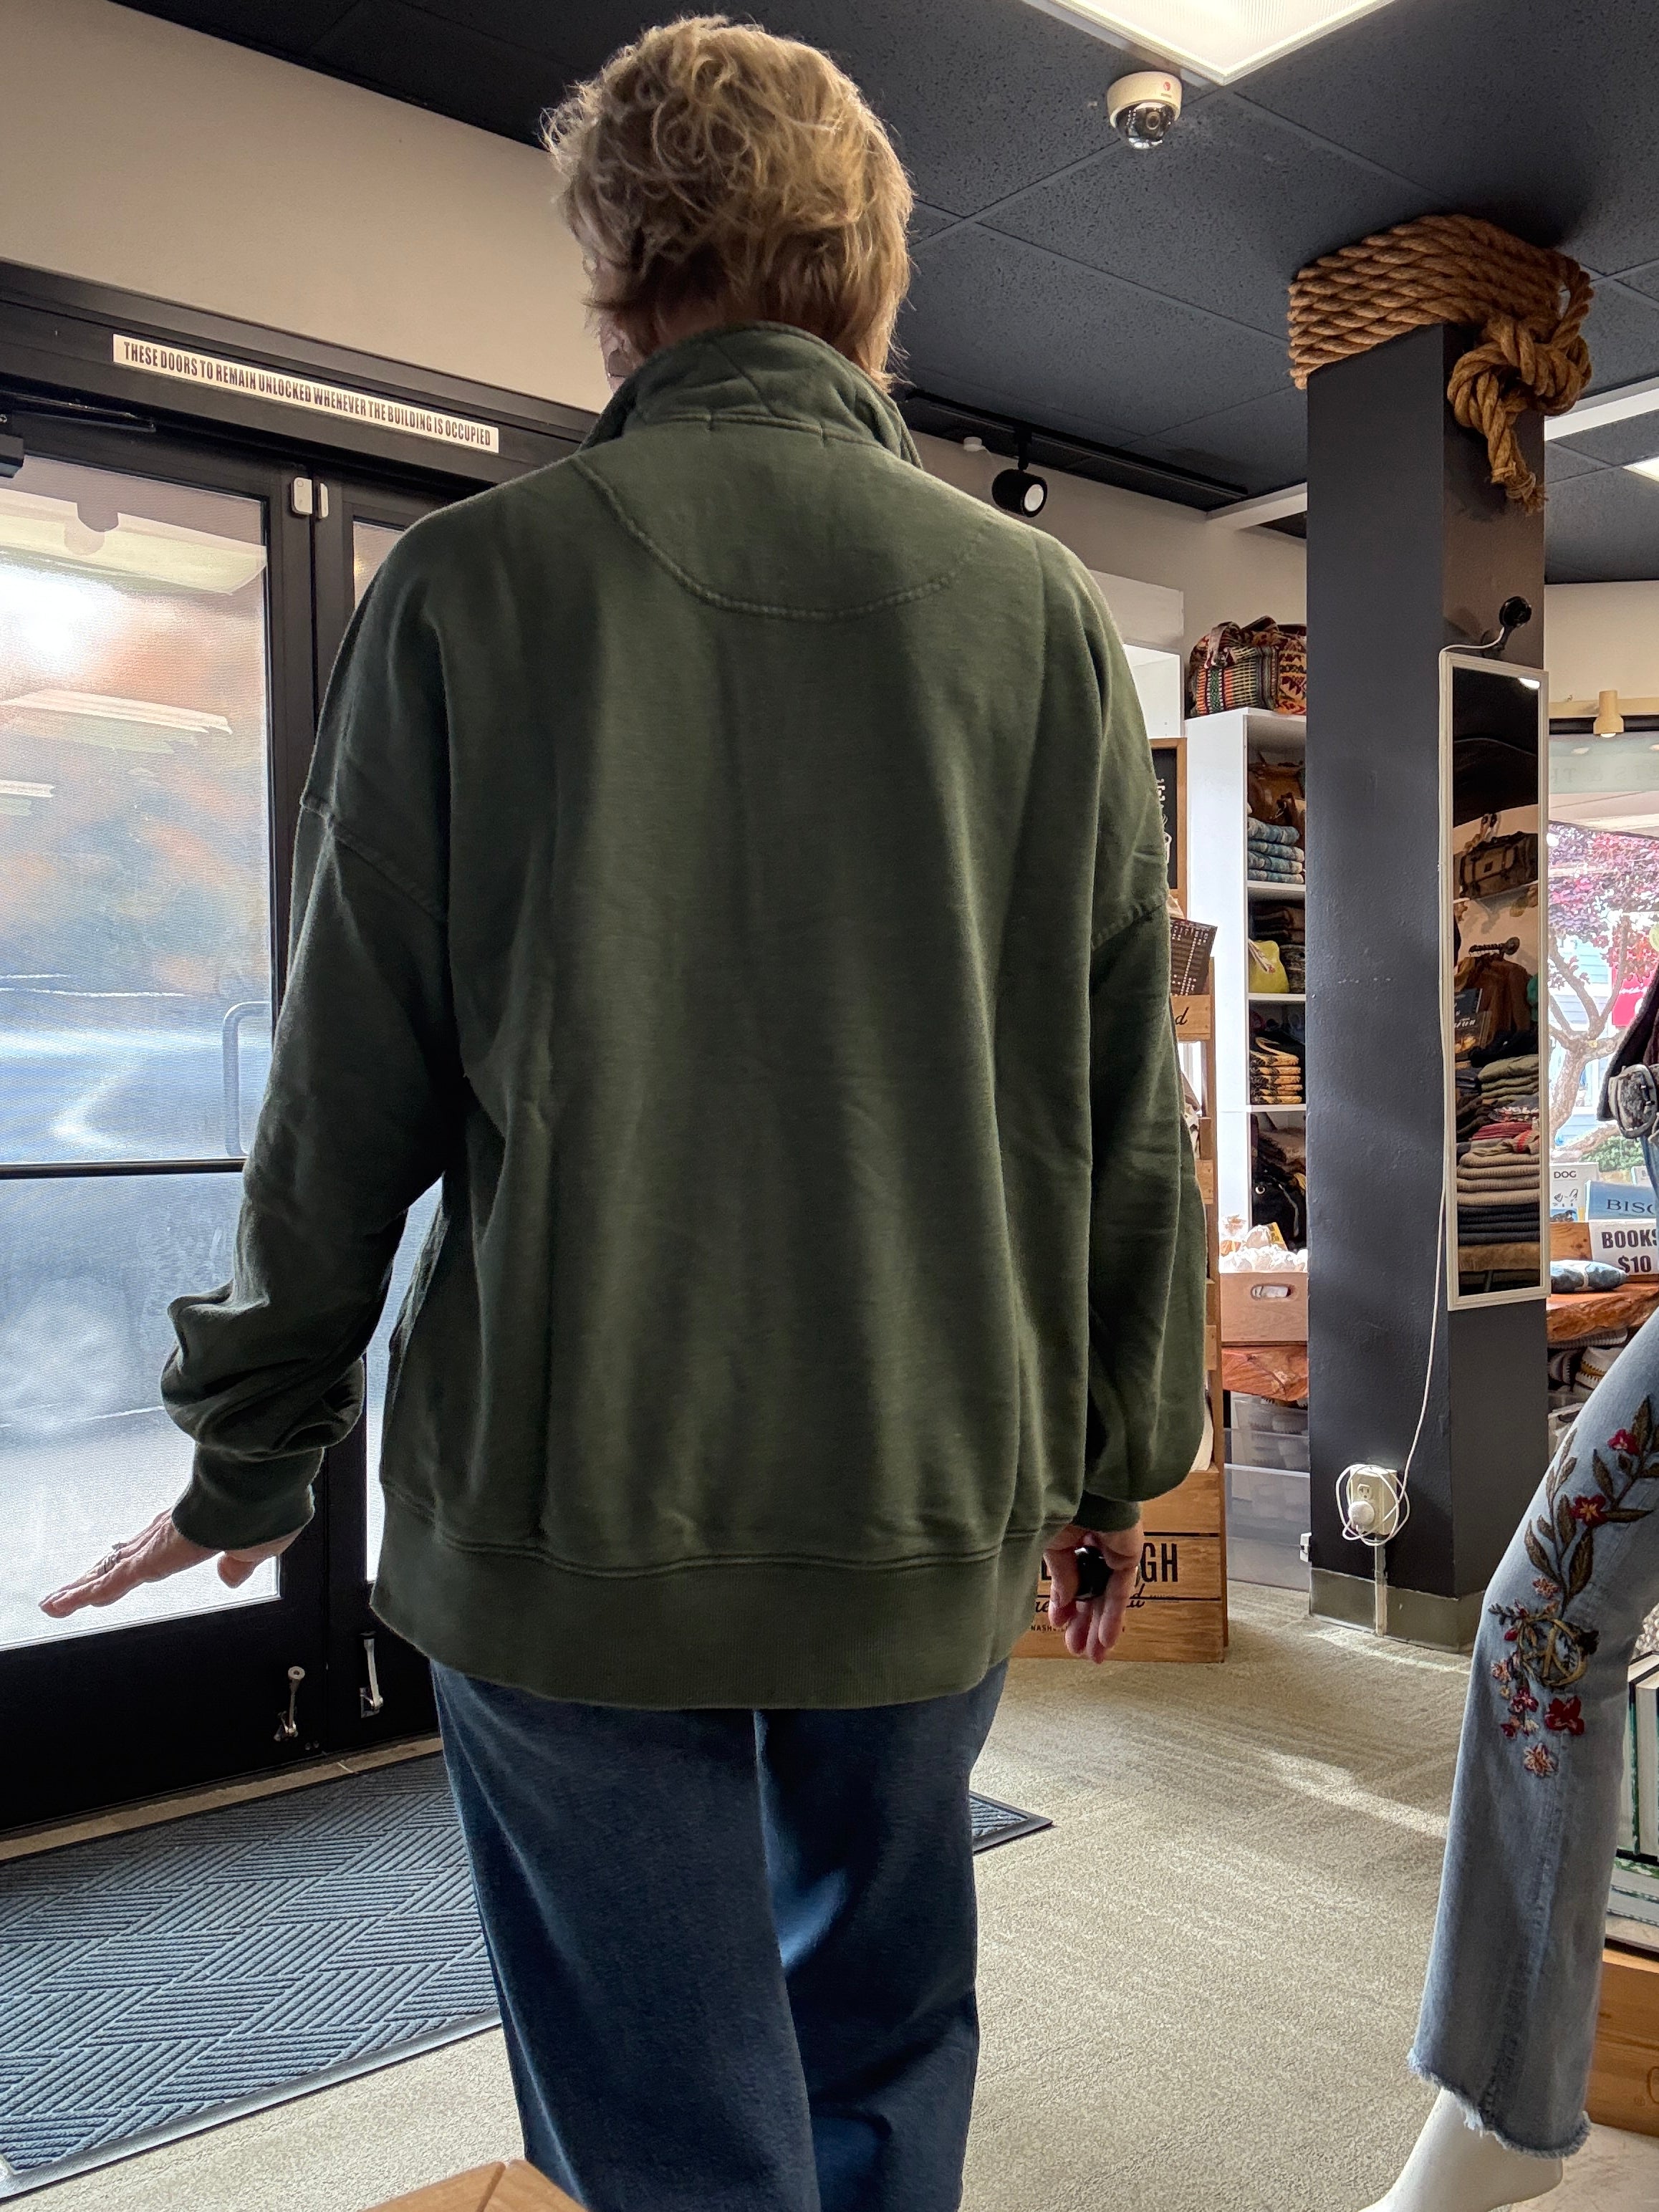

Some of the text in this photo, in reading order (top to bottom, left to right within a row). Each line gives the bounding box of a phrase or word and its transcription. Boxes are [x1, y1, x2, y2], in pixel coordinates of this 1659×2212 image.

[123, 341, 491, 446] THESE DOORS TO REMAIN UNLOCKED WHENEVER THE BUILDING IS OCCUPIED
[1554, 1170, 1577, 1179] DOG
[1617, 1255, 1652, 1273] $10
